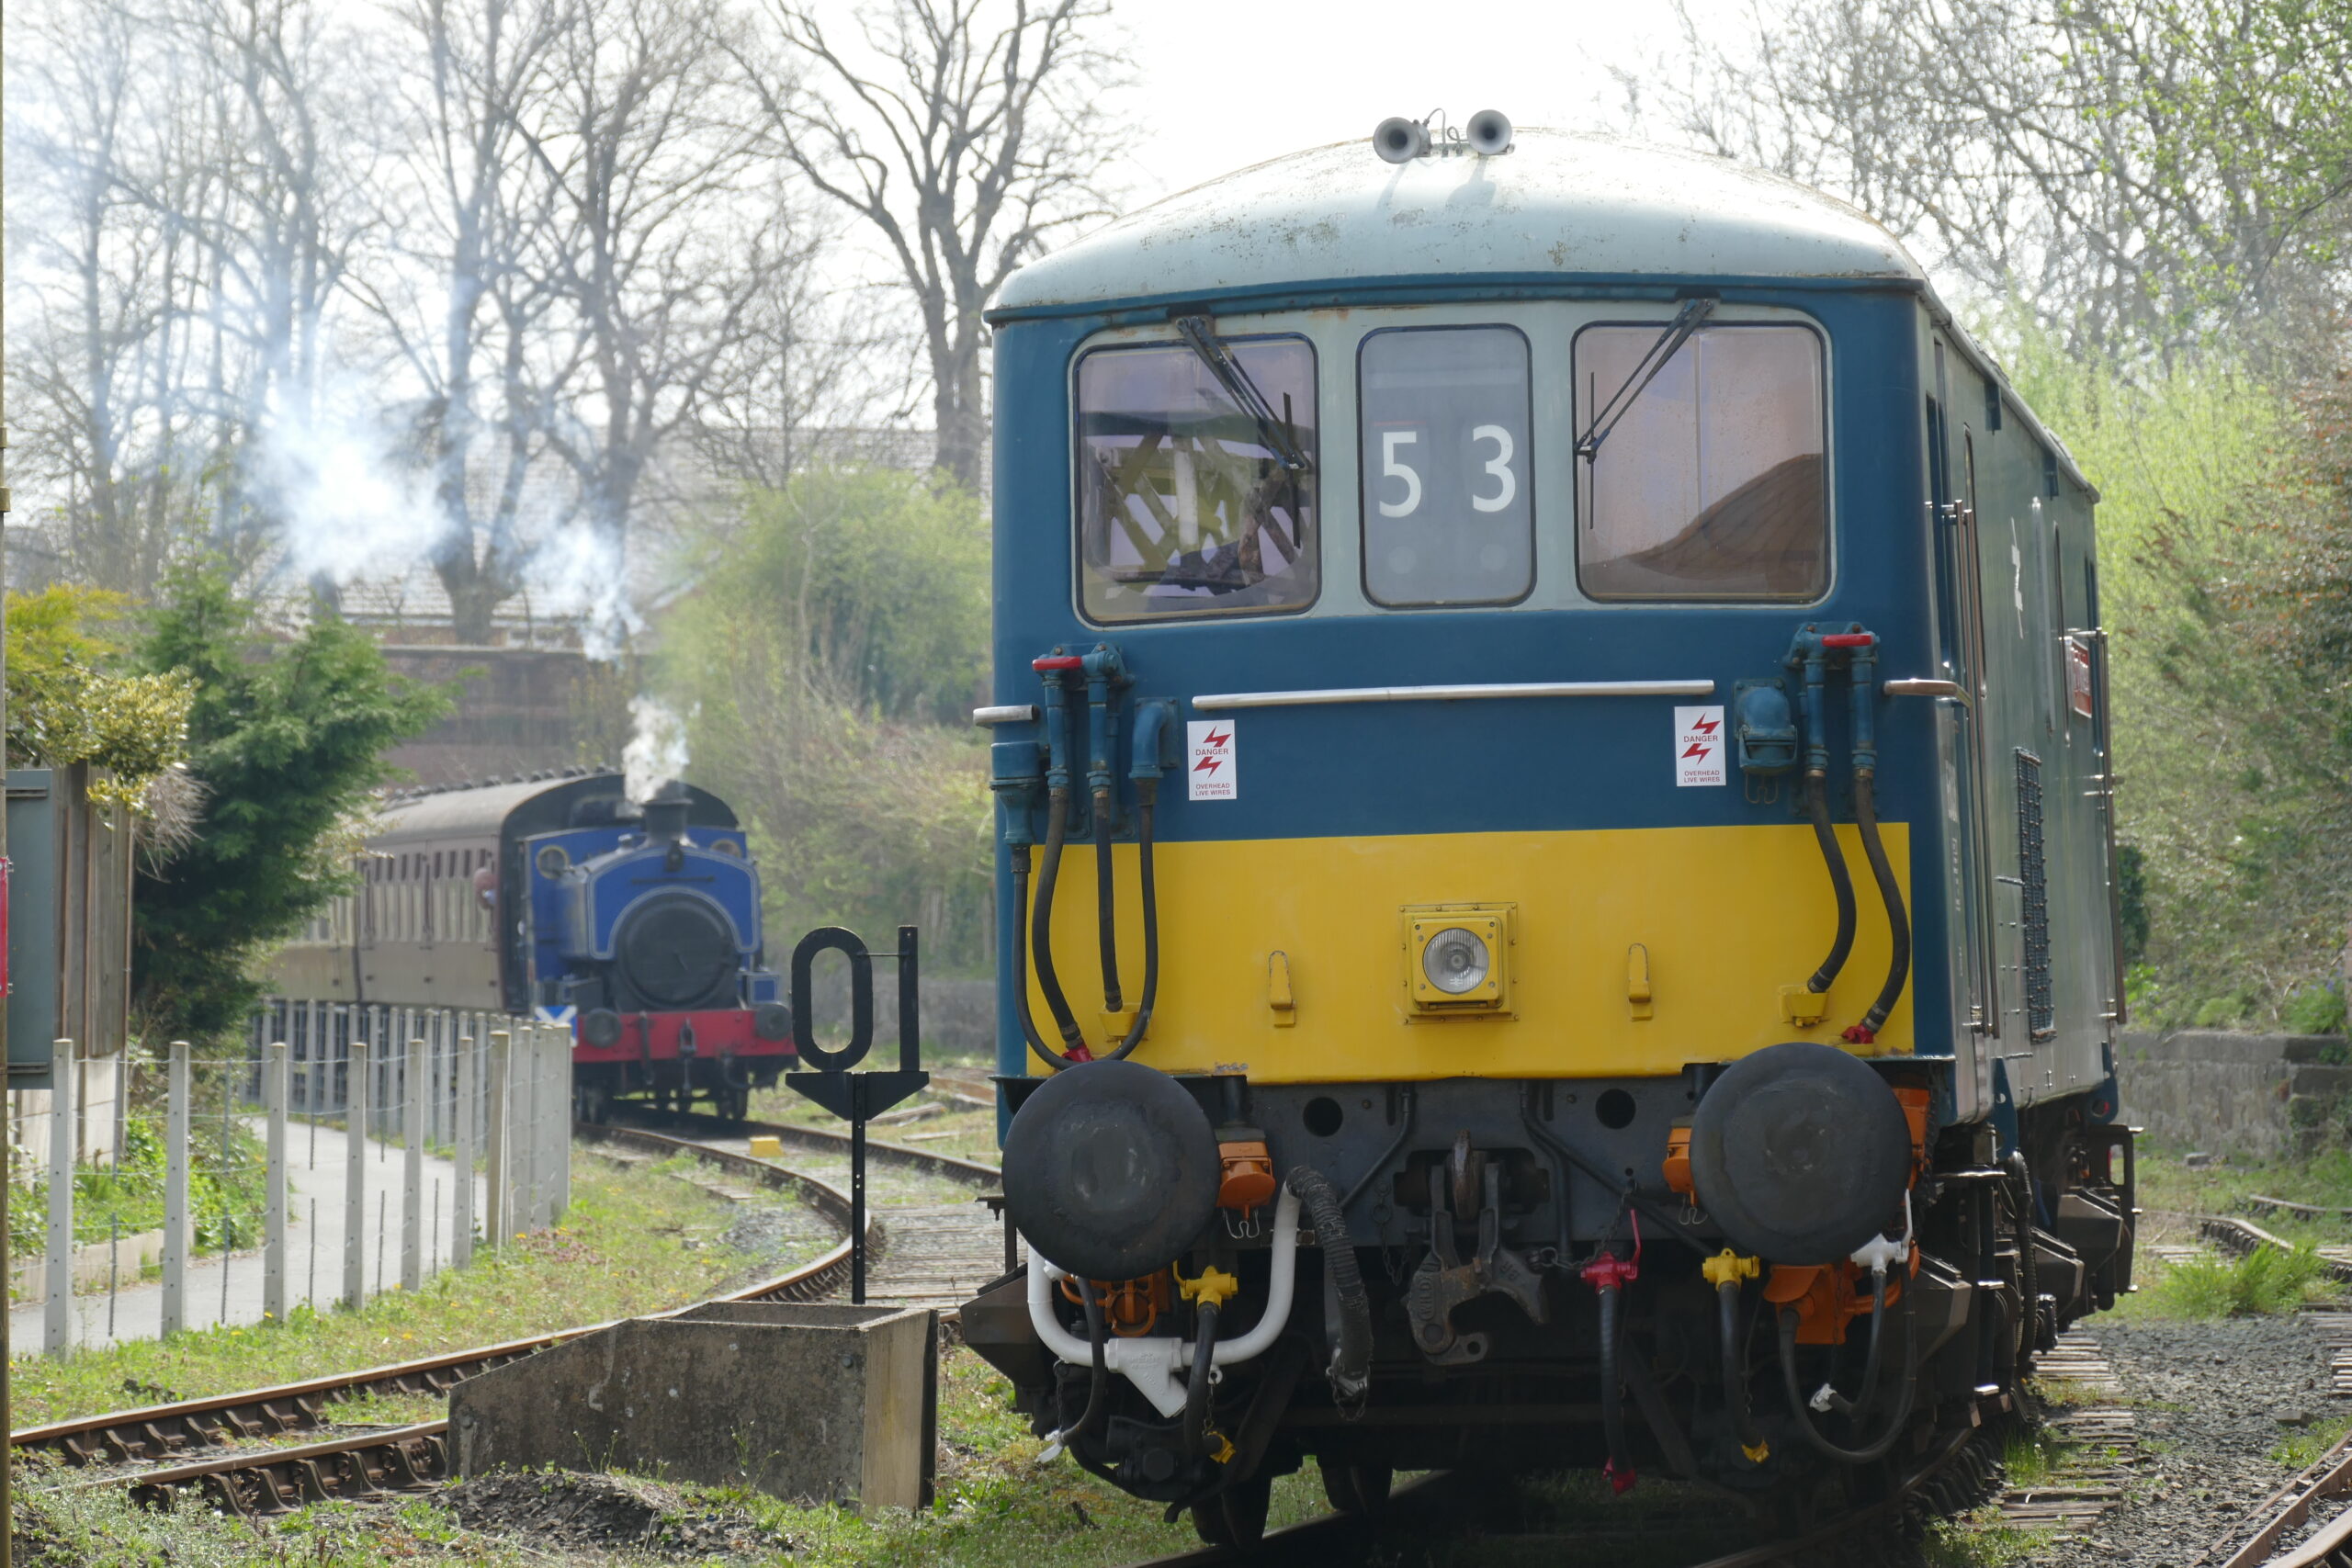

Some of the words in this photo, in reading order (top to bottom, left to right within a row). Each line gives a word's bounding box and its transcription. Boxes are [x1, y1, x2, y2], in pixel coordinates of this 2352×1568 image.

[1379, 431, 1422, 518] 5
[1473, 424, 1516, 513] 3
[1684, 735, 1718, 743] DANGER
[1195, 748, 1229, 756] DANGER
